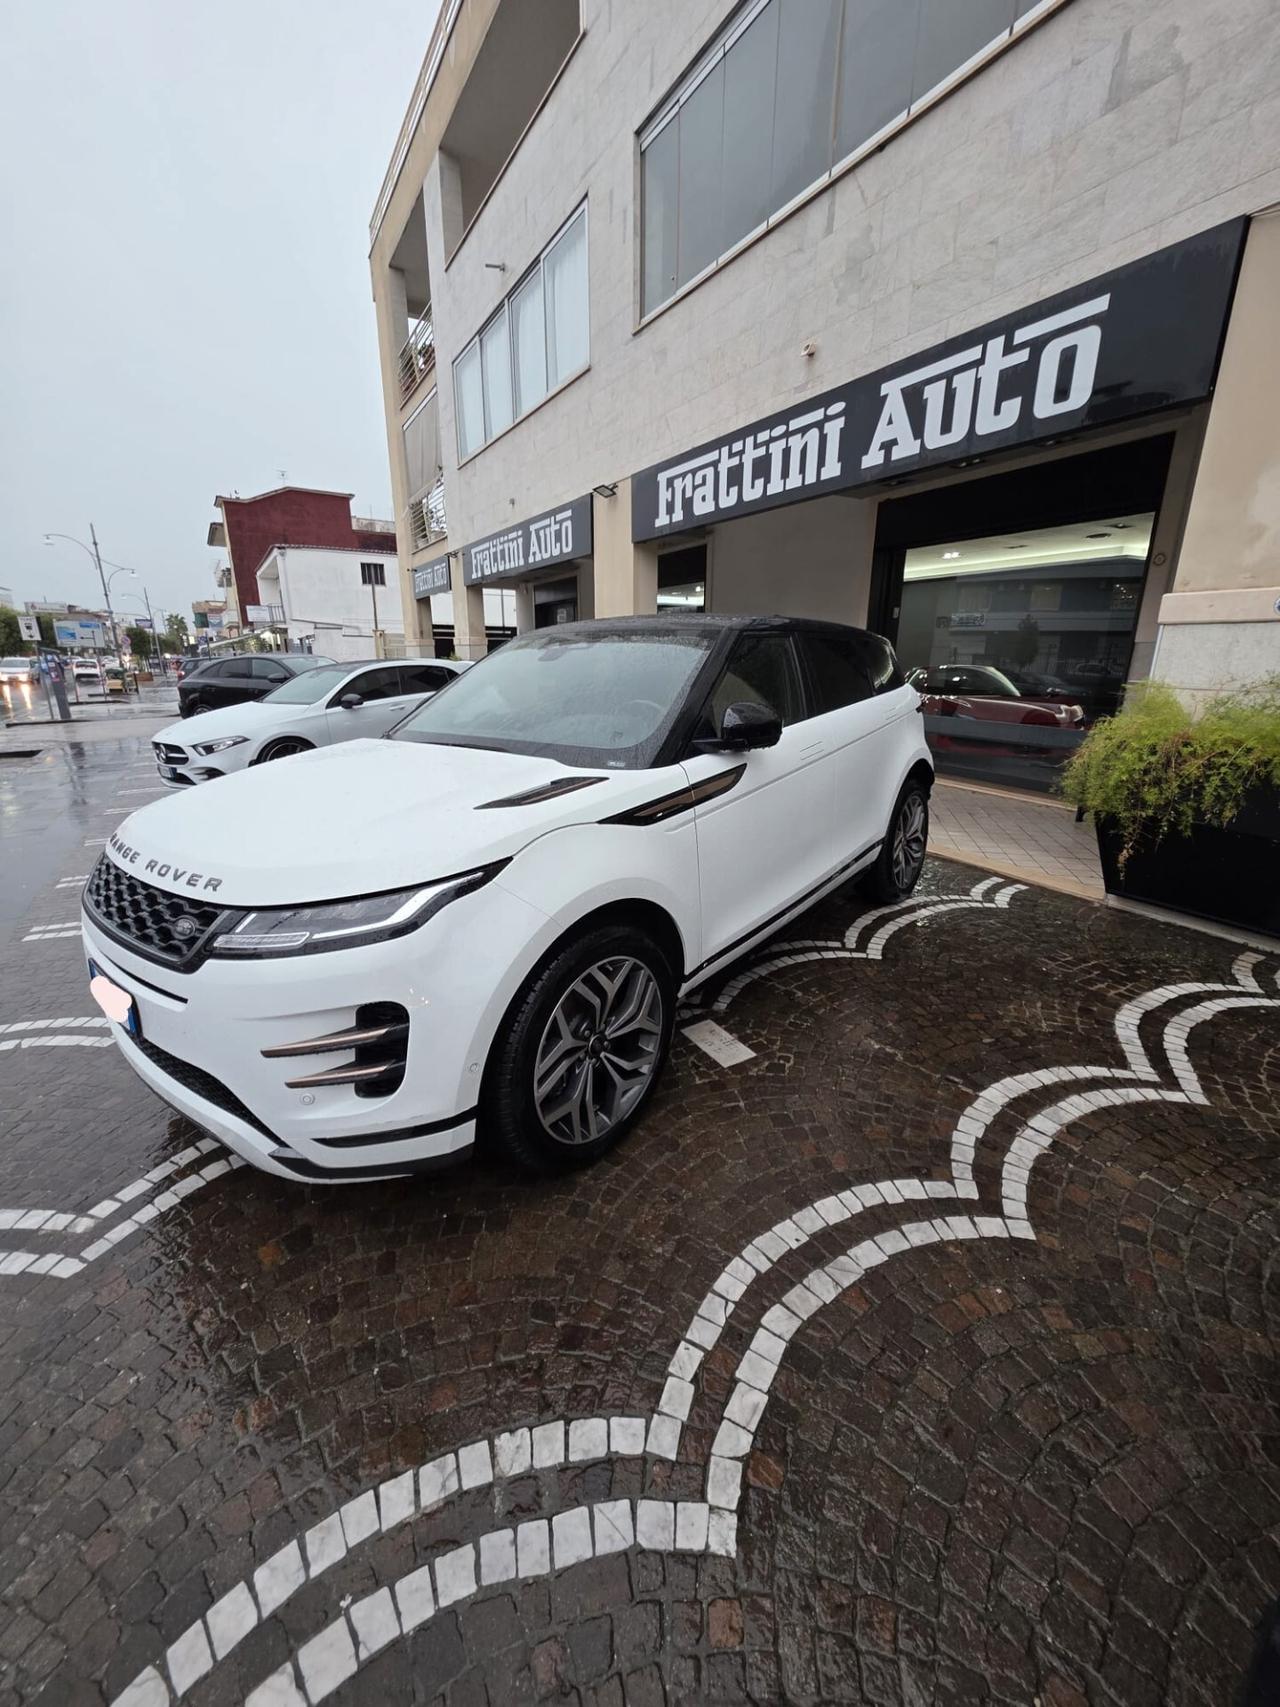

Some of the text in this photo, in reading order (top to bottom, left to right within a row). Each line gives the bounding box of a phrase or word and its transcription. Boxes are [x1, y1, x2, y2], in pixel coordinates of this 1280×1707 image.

[654, 293, 1111, 528] Frattini Auto
[471, 509, 573, 579] Frattini Auto
[109, 832, 223, 892] RANGE ROVER
